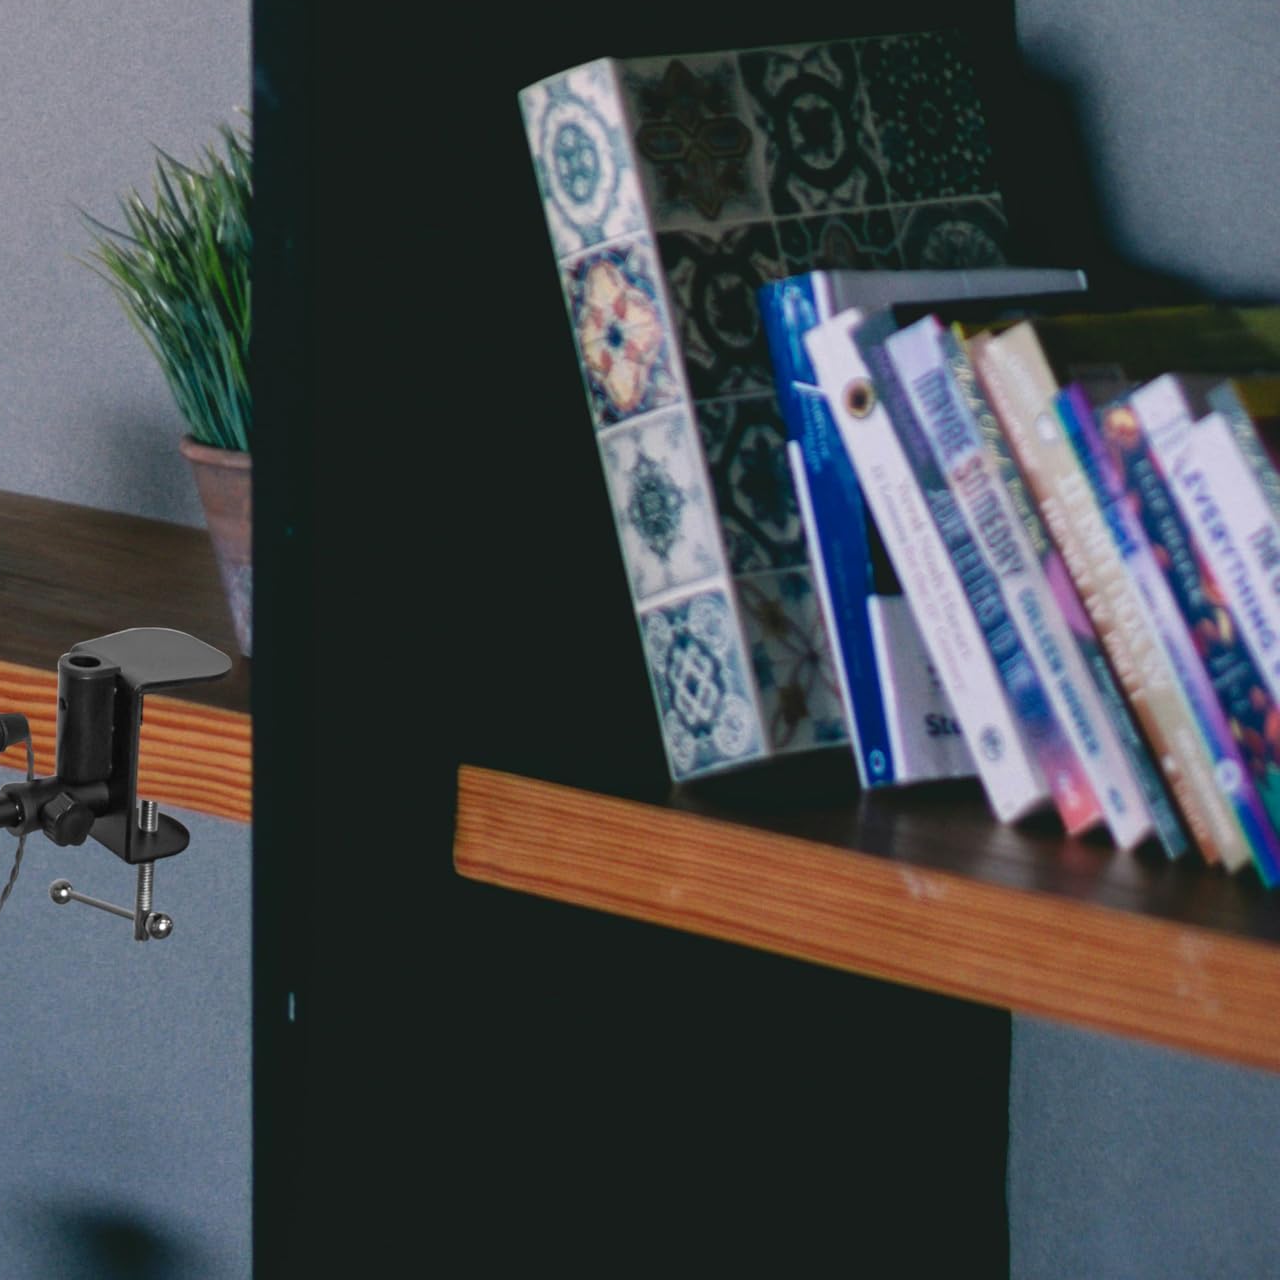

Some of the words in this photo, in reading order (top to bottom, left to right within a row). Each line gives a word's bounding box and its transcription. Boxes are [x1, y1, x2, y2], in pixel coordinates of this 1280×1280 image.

[912, 364, 977, 462] MAYBE
[949, 451, 1029, 581] SOMEDAY
[1181, 468, 1279, 650] EVERYTHING
